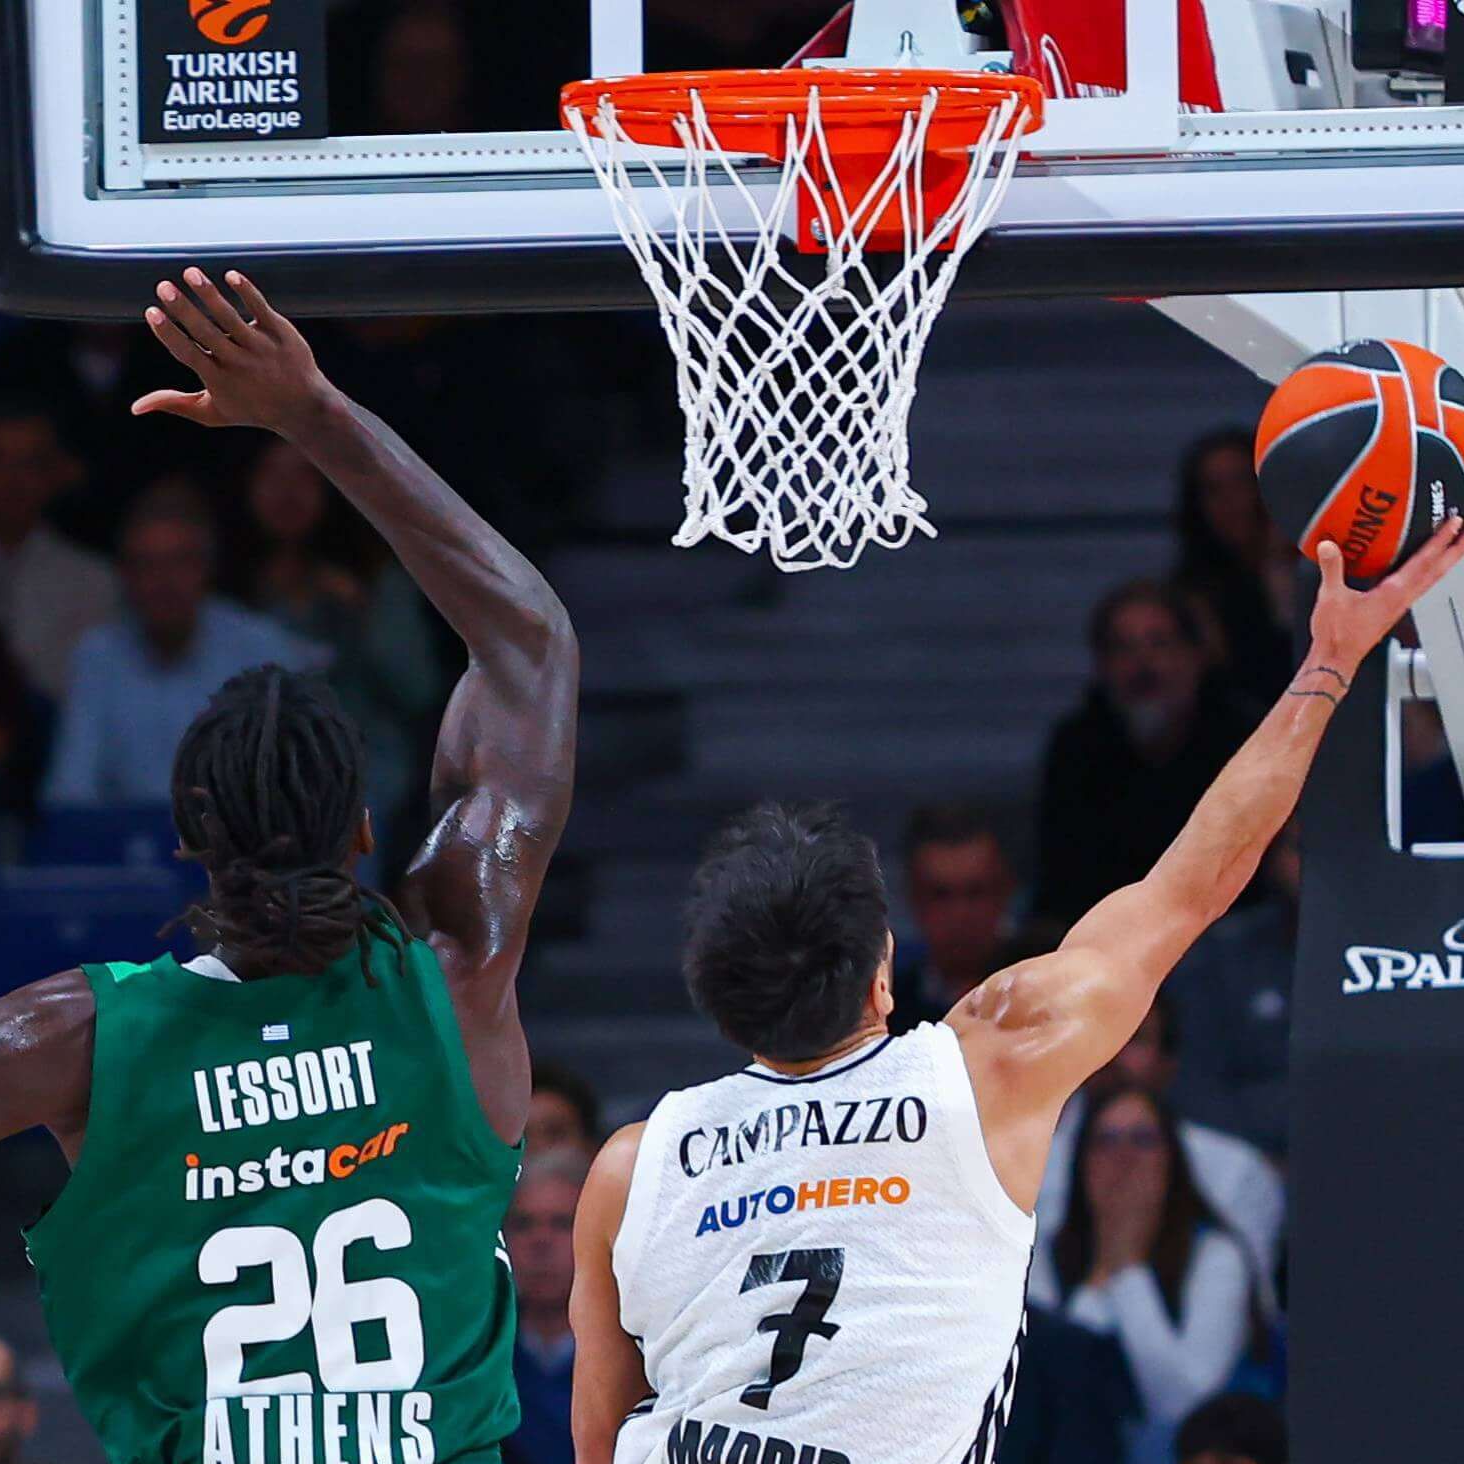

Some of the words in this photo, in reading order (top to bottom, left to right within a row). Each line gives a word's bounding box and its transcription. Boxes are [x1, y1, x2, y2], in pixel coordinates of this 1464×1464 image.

[165, 51, 297, 78] TURKISH
[165, 78, 299, 105] AIRLINES
[163, 109, 301, 135] EuroLeague
[192, 1040, 377, 1134] LESSORT
[184, 1121, 410, 1201] instacar
[678, 1095, 928, 1178] CAMPAZZO
[694, 1175, 910, 1238] AUTOHERO
[197, 1198, 426, 1400] 26
[739, 1247, 846, 1411] 7
